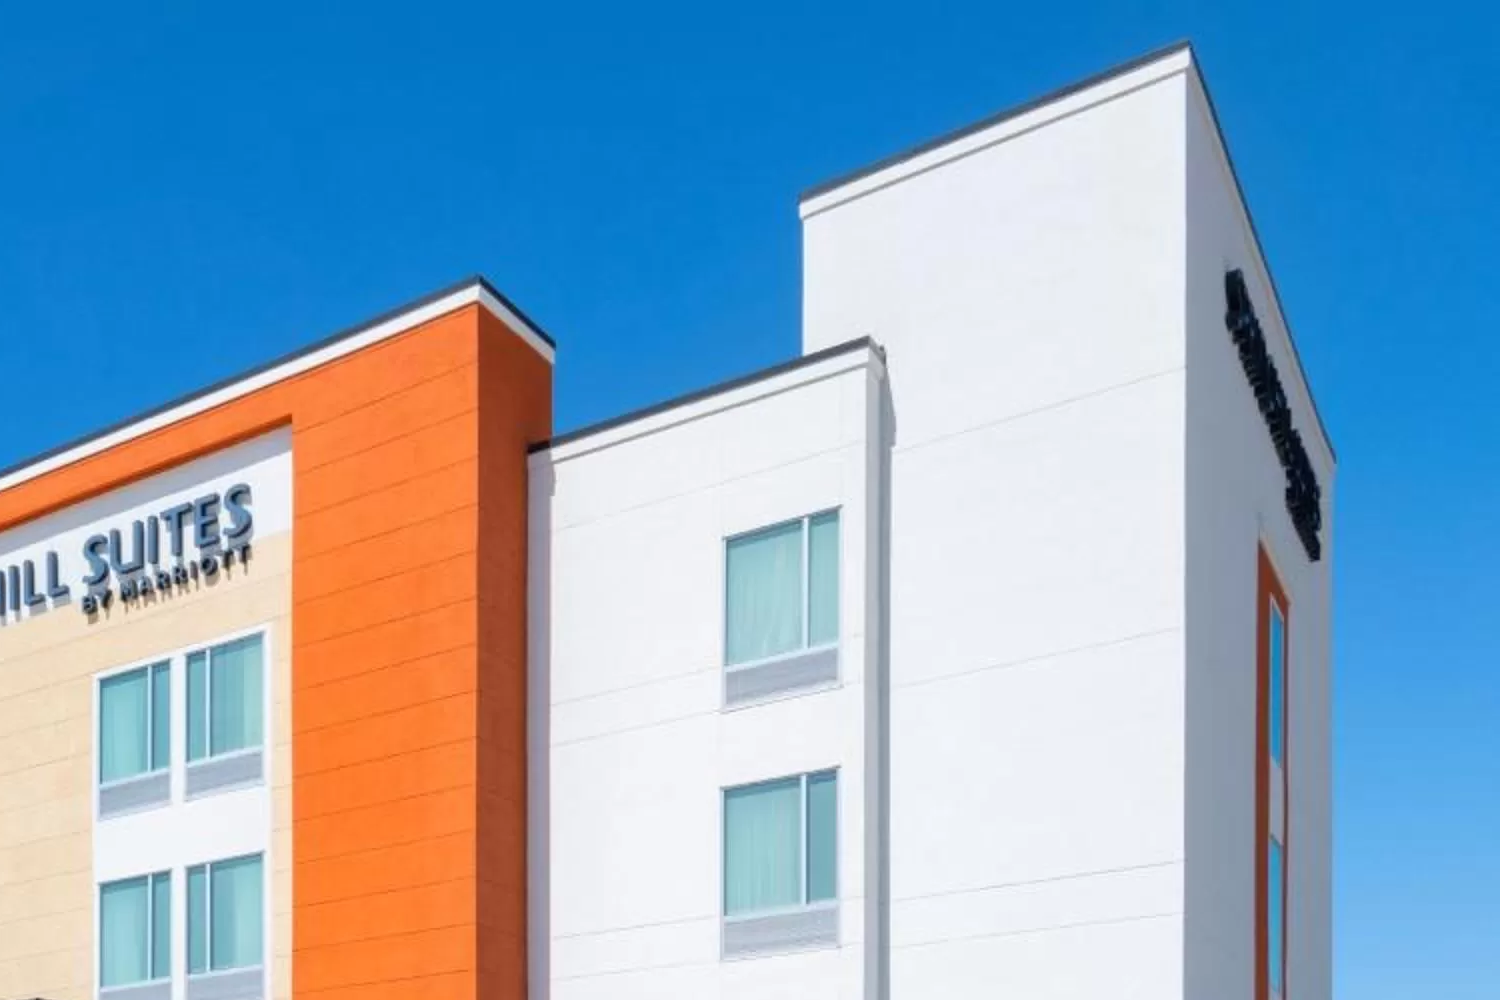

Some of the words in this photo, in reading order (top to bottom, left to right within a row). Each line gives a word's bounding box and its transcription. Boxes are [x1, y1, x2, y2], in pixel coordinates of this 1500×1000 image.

[82, 484, 252, 586] SUITES
[82, 589, 113, 615] BY
[120, 543, 252, 602] MARRIOTT
